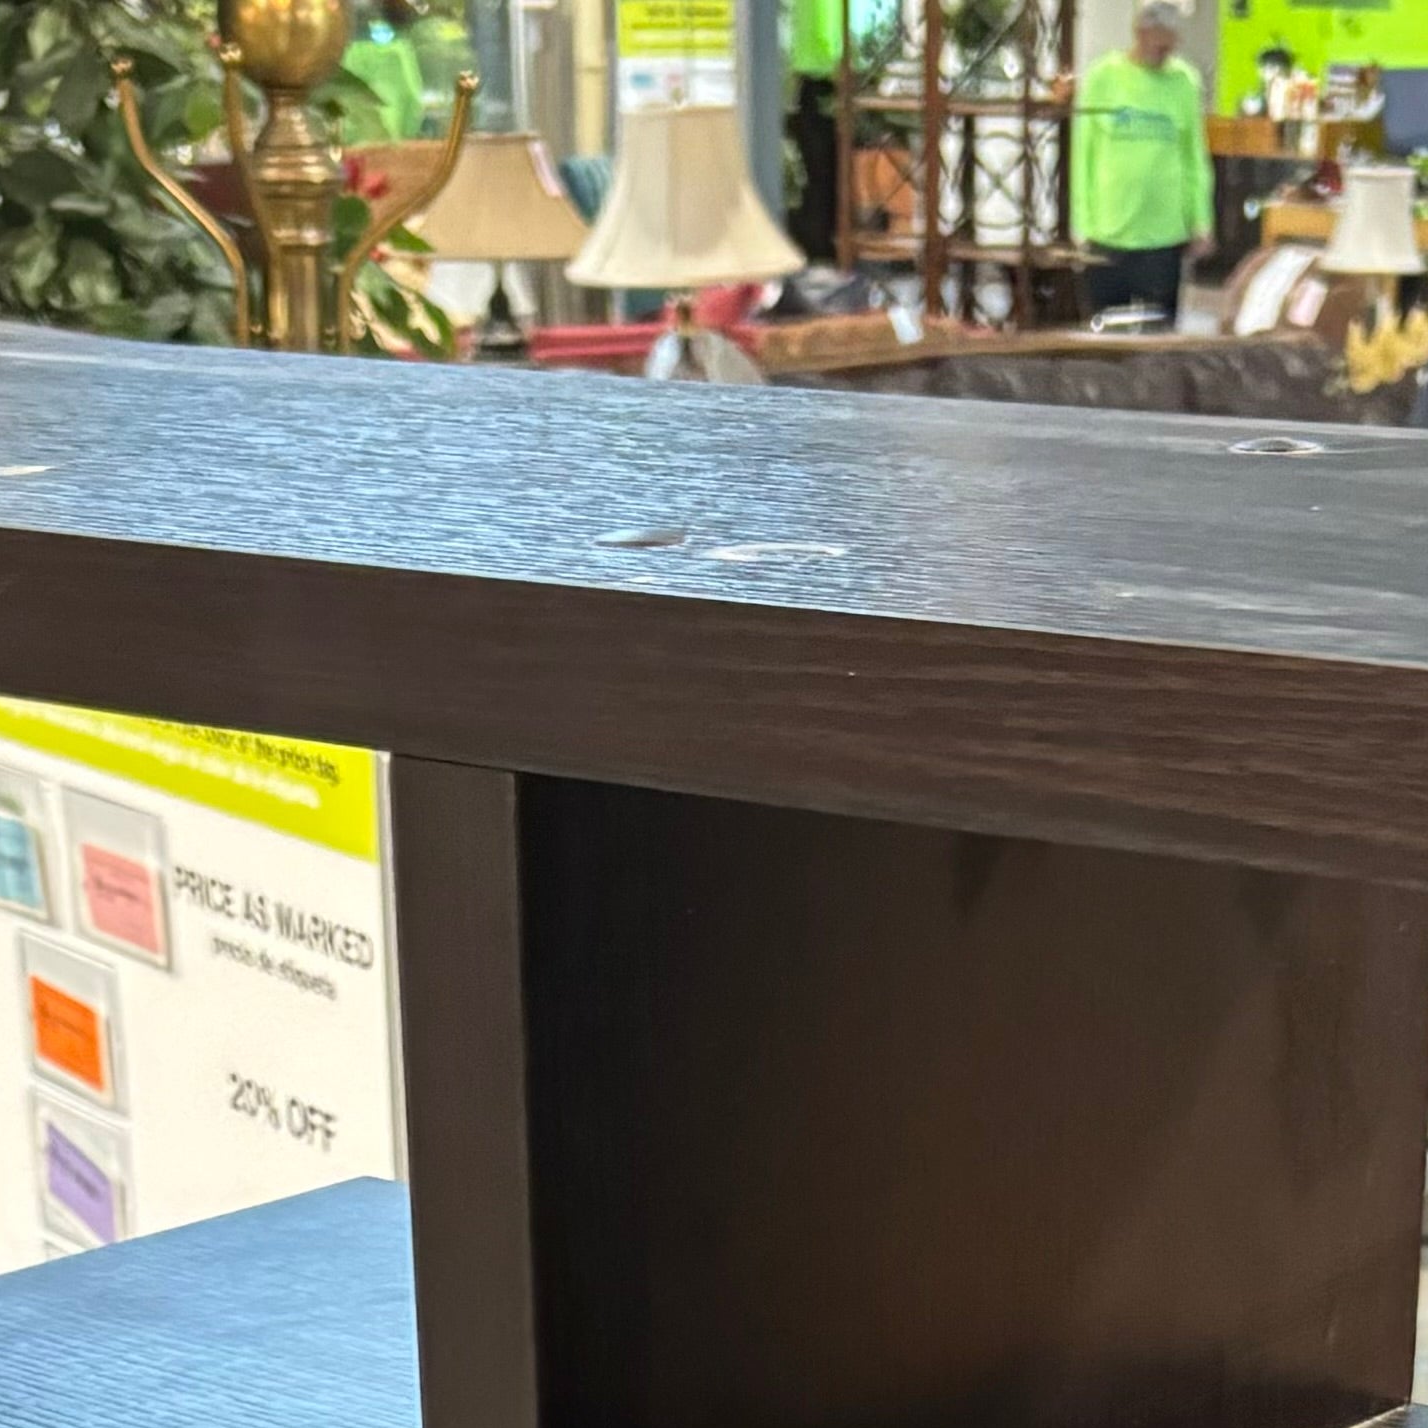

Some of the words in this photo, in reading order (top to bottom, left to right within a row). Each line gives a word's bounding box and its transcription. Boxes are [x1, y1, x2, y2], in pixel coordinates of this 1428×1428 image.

[173, 866, 236, 919] PRICE
[241, 890, 271, 933] AS
[273, 900, 374, 971] MARKED
[228, 1071, 283, 1132] 20%
[285, 1097, 338, 1154] OFF
